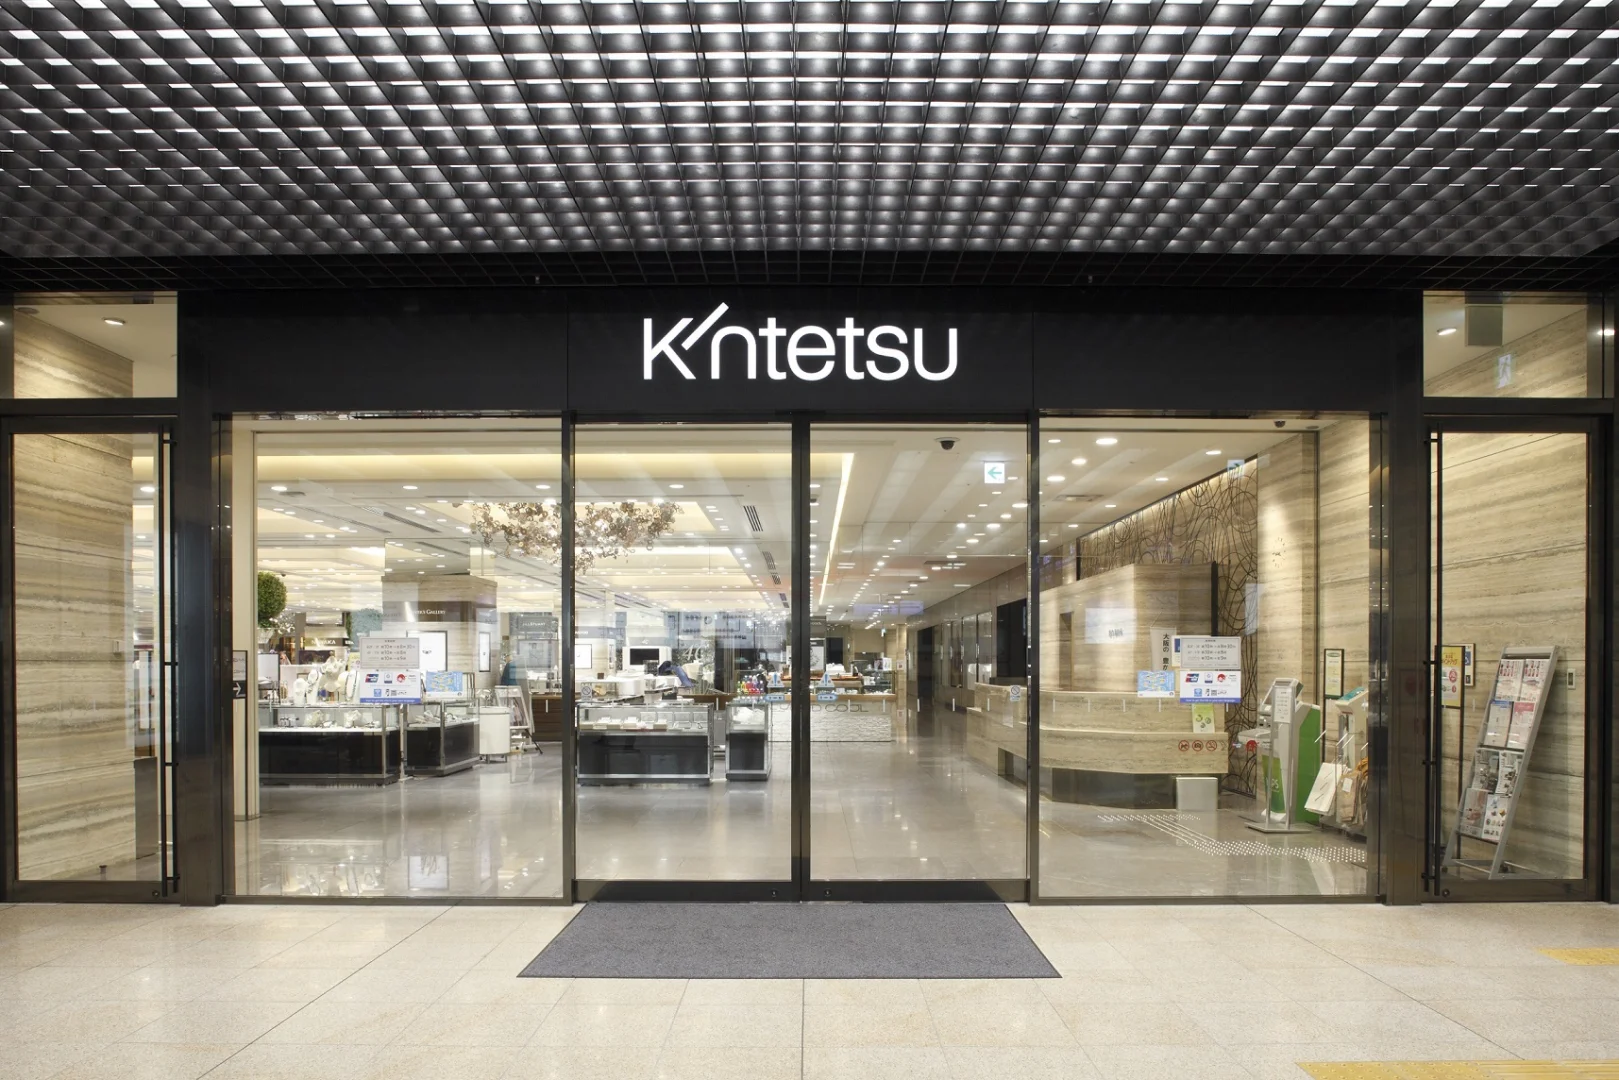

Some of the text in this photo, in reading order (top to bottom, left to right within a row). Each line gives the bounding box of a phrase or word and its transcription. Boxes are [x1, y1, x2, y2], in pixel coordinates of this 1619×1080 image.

[643, 302, 958, 381] Kintetsu
[1162, 633, 1170, 653] 大阪の
